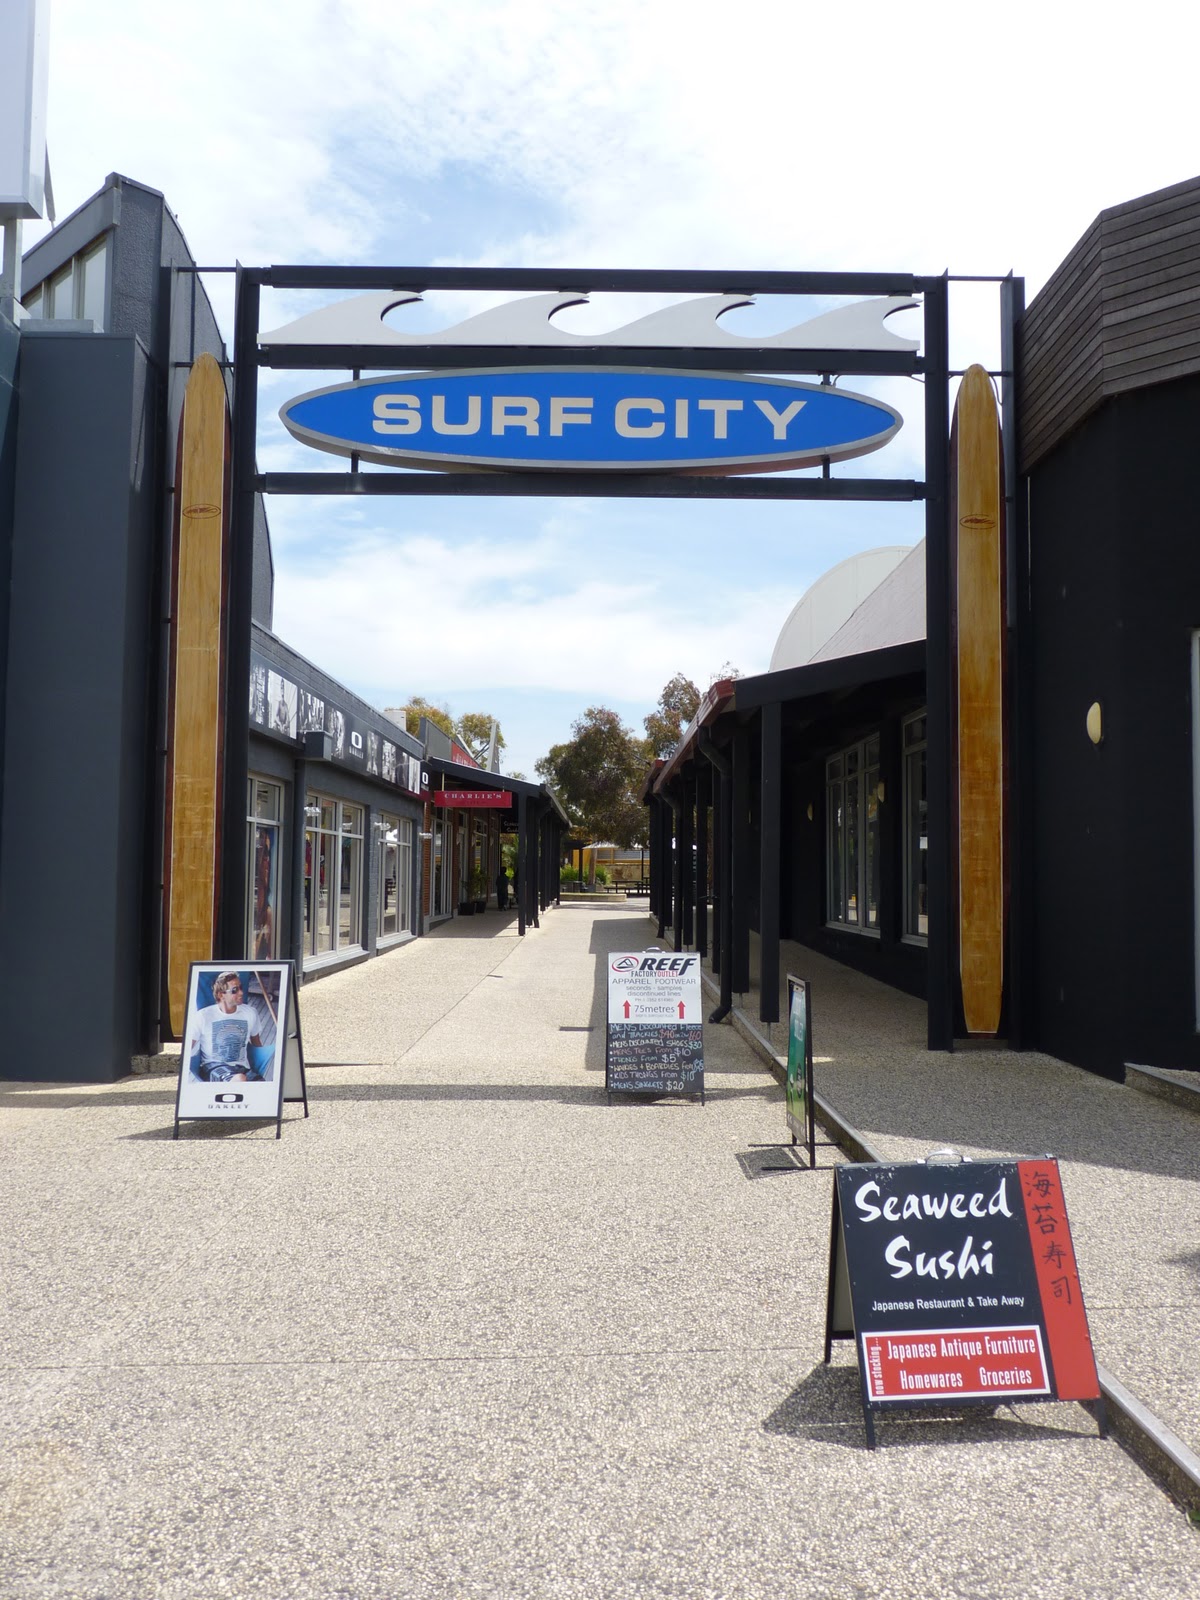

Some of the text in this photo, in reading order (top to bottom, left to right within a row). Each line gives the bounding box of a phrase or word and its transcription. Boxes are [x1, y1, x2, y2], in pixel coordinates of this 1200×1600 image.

[372, 394, 808, 440] SURF CITY
[639, 958, 697, 976] REEF
[661, 1053, 677, 1063] $5
[674, 1048, 691, 1059] $10
[666, 1080, 684, 1091] $20
[855, 1178, 1014, 1222] Seaweed
[885, 1235, 994, 1280] Sushi
[872, 1295, 1024, 1312] Japanese Restaurant & Take Away
[887, 1336, 1036, 1363] Japanese Antique Furniture
[900, 1366, 1032, 1390] Homewares Groceries
[876, 1380, 884, 1395] now
